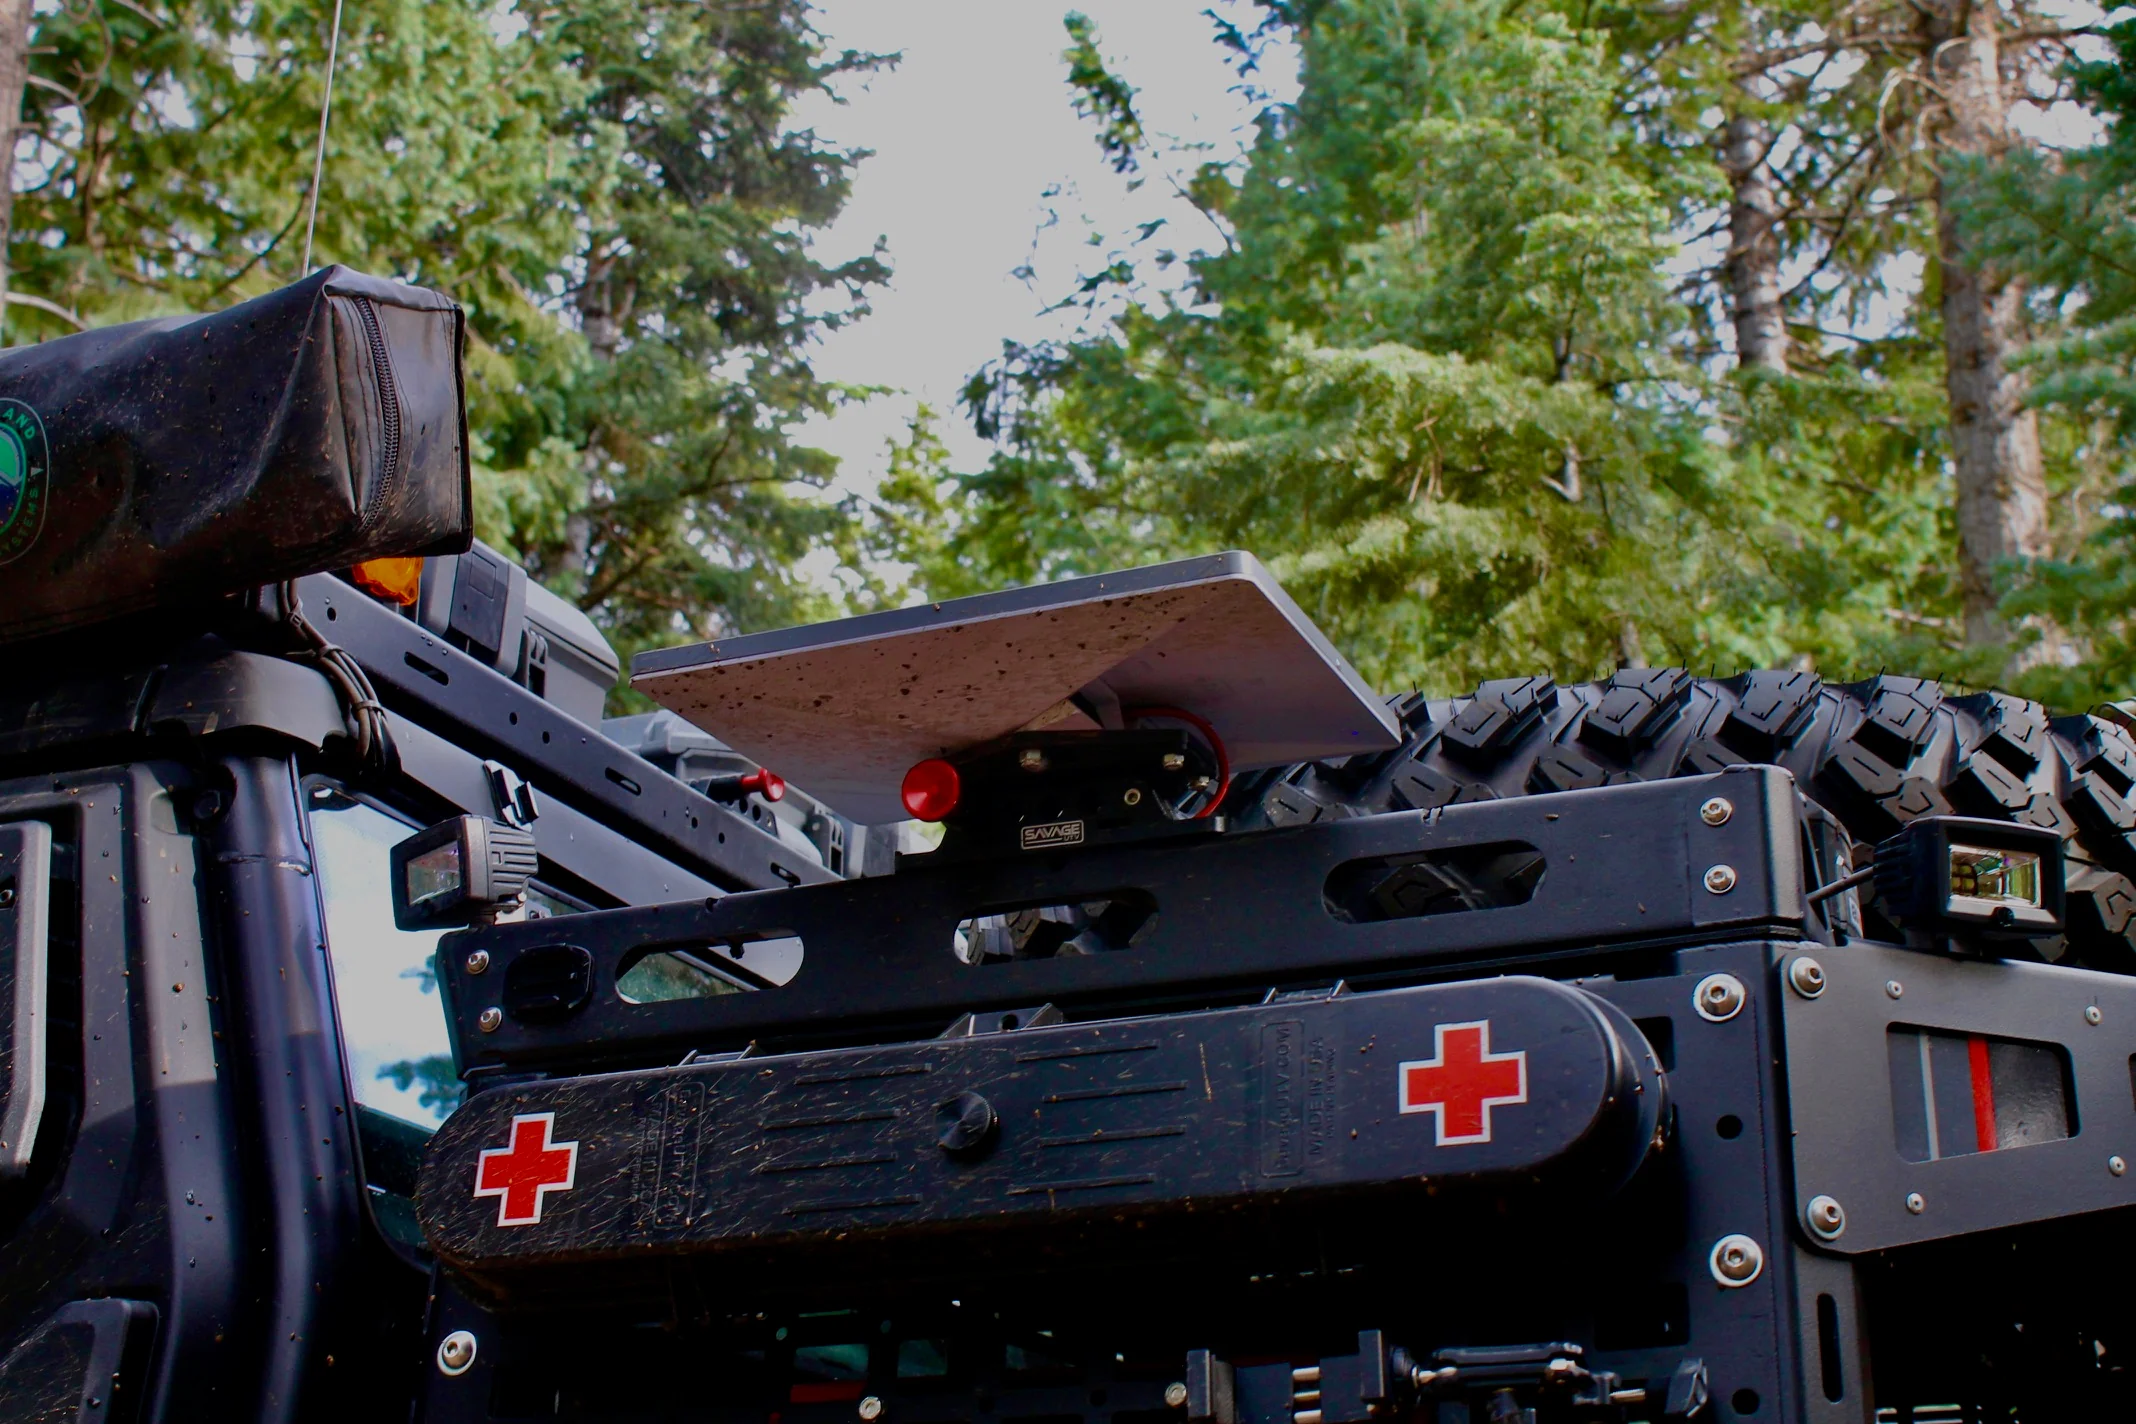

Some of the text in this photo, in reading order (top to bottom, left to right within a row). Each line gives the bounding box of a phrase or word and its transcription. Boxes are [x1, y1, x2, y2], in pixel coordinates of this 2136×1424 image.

[2, 407, 36, 440] AND
[1024, 823, 1080, 841] SAVAGE
[1309, 1078, 1323, 1096] IN
[1308, 1100, 1324, 1155] MADE
